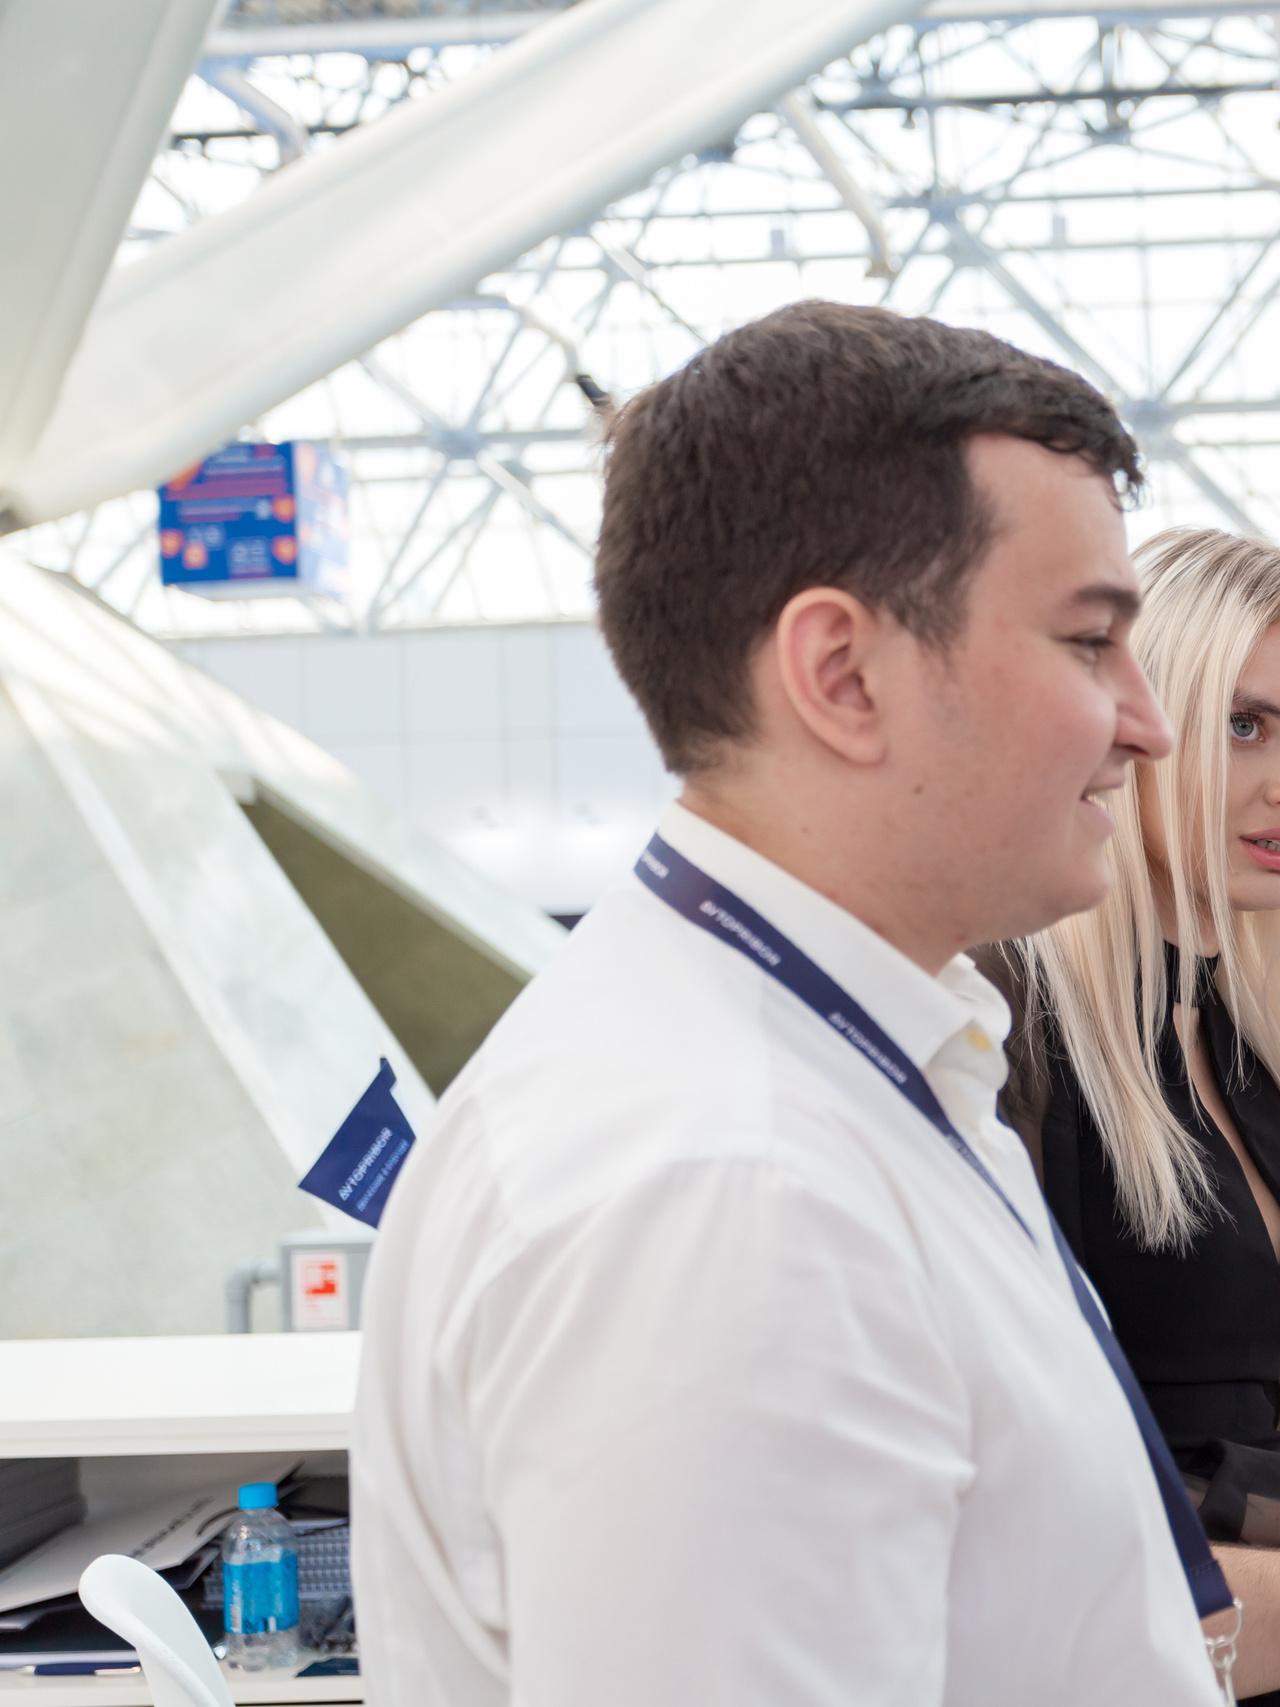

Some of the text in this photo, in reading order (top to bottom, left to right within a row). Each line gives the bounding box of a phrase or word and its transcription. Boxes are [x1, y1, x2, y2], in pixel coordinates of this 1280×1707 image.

[699, 900, 781, 967] AVTOPRIBOR
[828, 1012, 908, 1084] AVTOPRIBOR
[338, 1127, 393, 1201] AVTOPRIBOR
